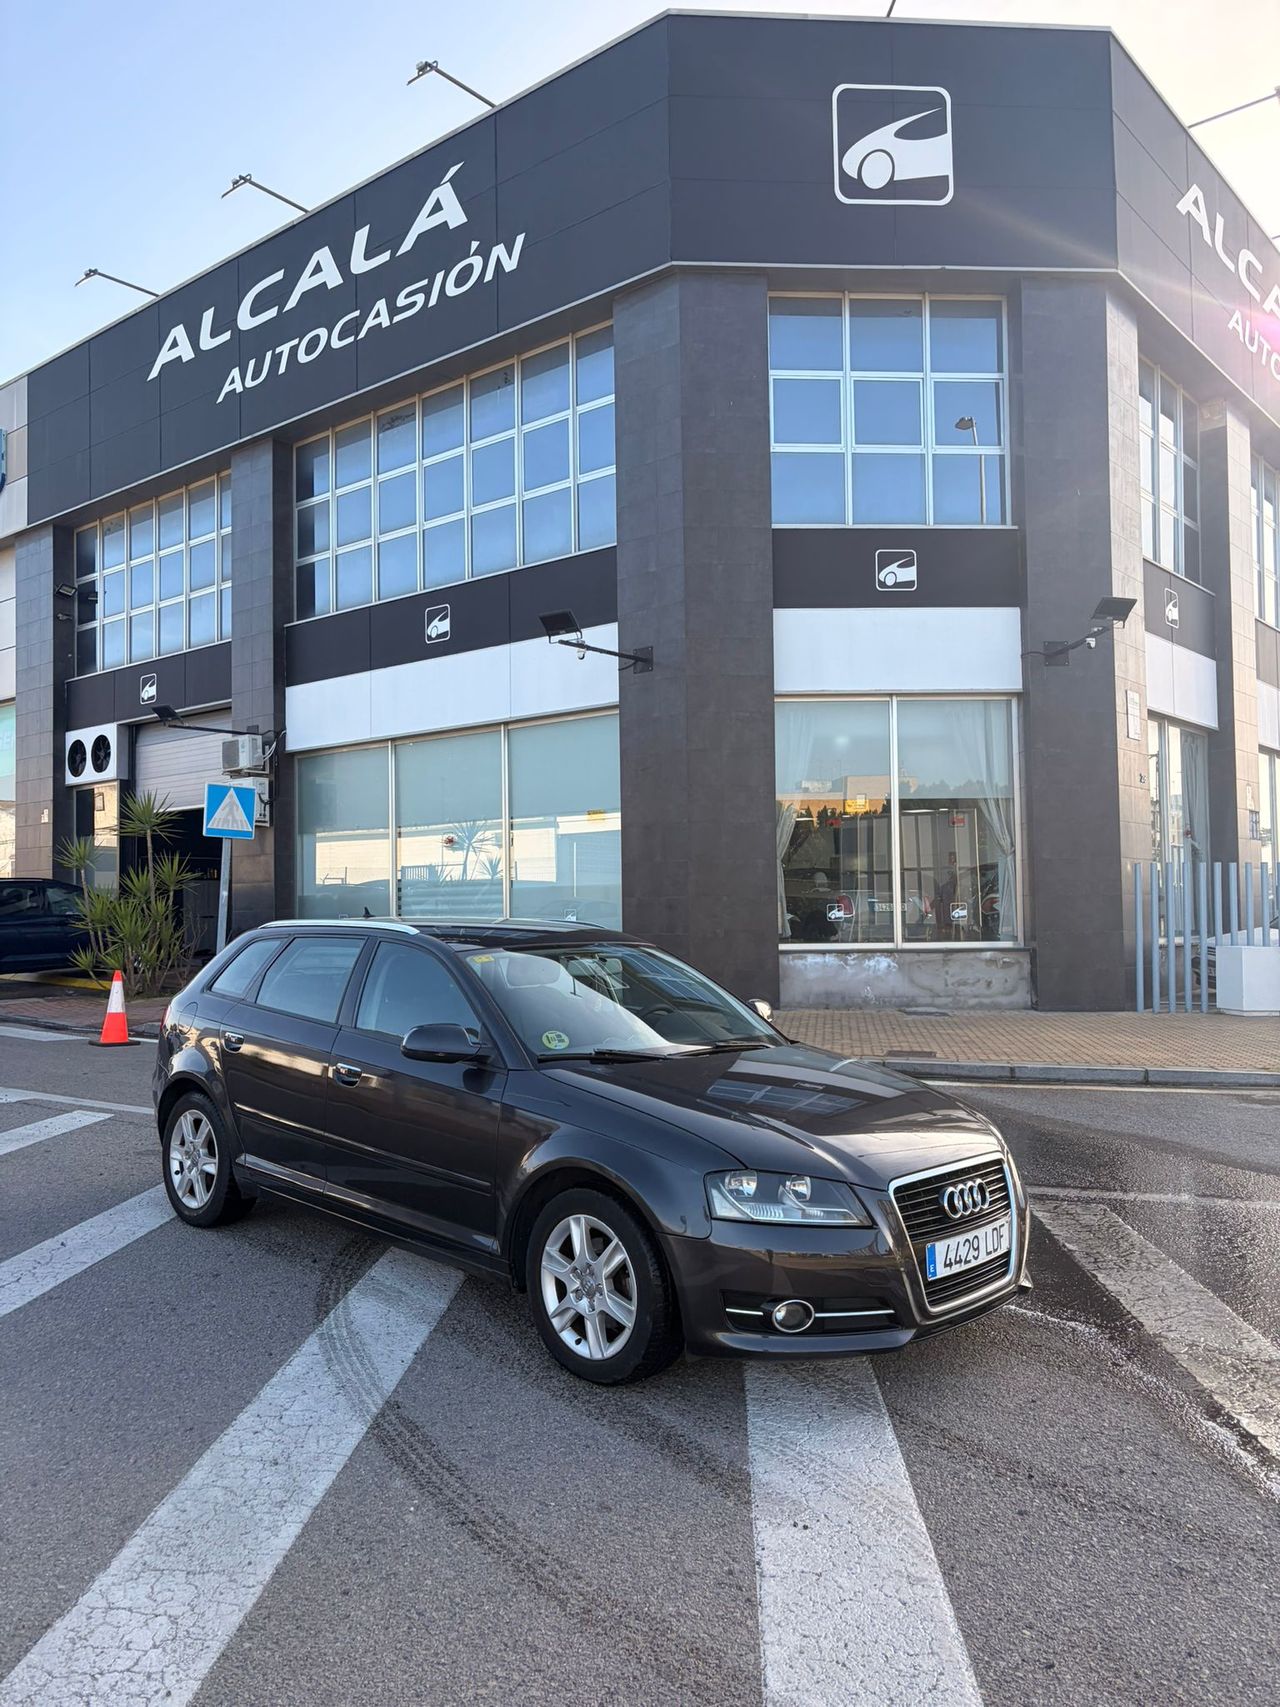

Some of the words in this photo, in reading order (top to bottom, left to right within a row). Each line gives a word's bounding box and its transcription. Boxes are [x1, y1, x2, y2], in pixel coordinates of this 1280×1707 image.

[147, 161, 468, 382] ALCALÁ
[216, 233, 526, 403] AUTOCASIÓN
[943, 1234, 980, 1270] 4429
[985, 1223, 1005, 1256] LDF
